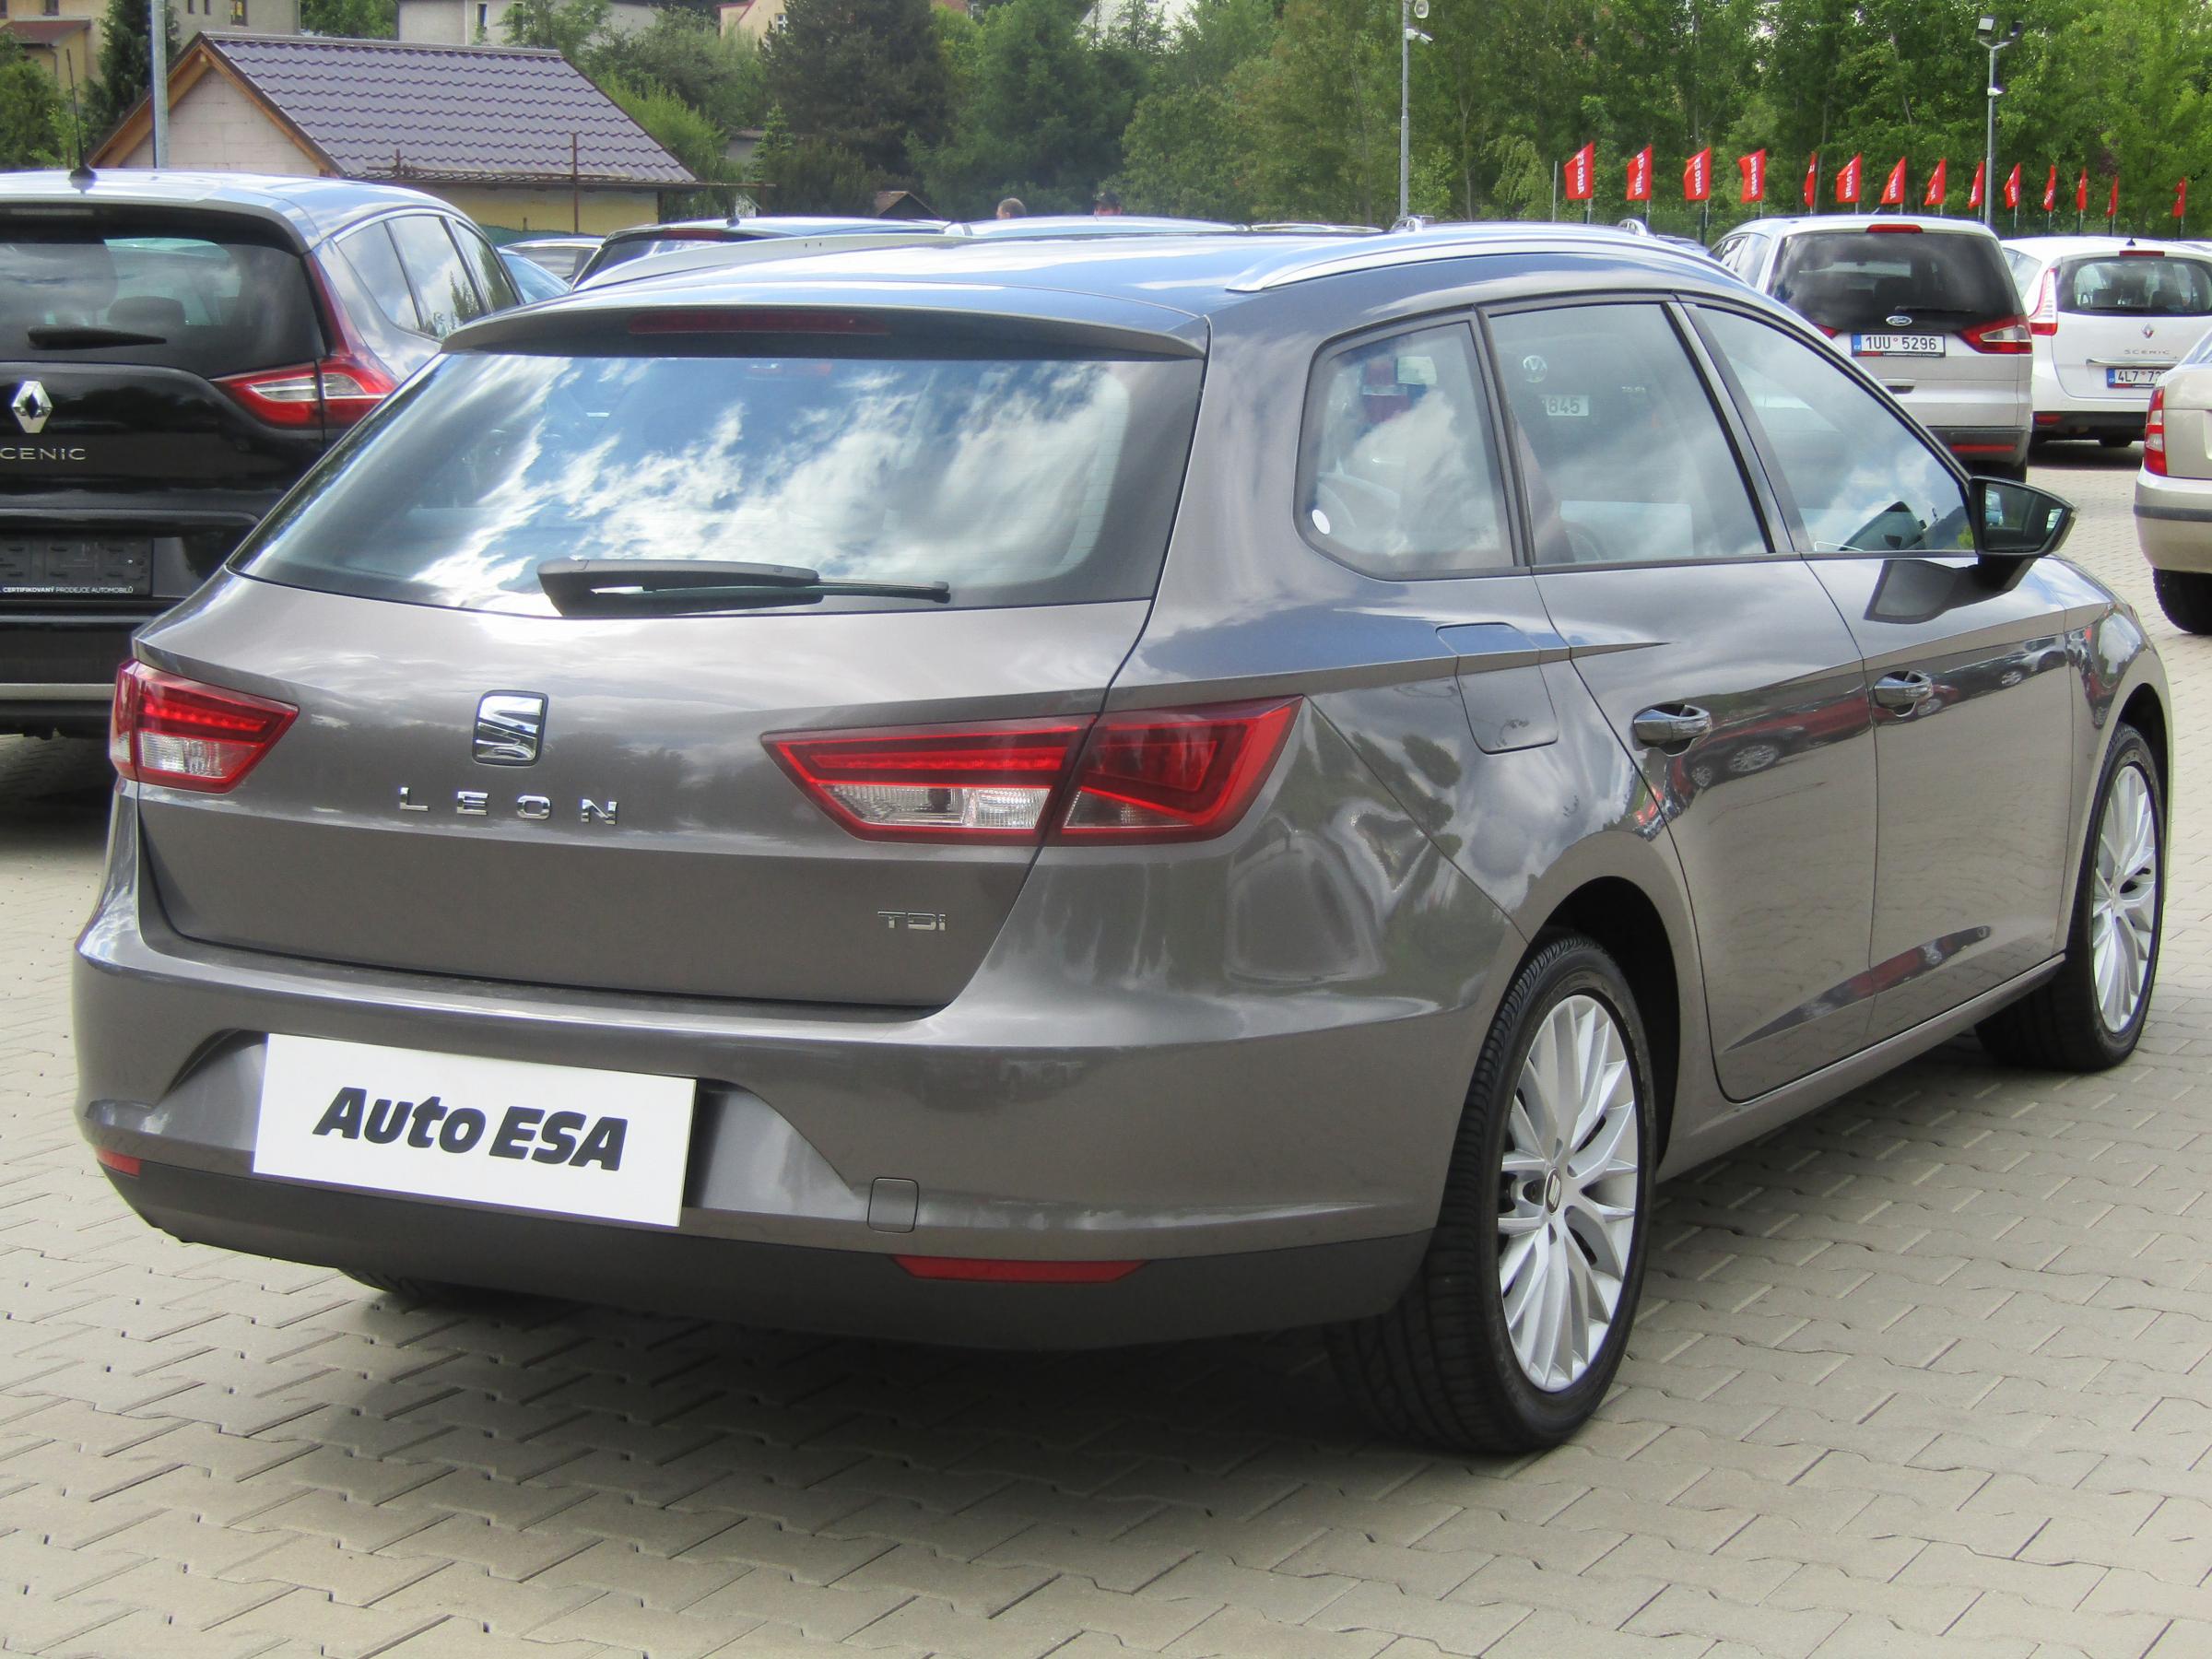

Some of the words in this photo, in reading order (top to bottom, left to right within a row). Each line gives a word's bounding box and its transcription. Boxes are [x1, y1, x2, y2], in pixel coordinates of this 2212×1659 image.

[1865, 335, 1891, 349] 1UU
[1901, 336, 1937, 350] 5296
[2117, 371, 2138, 382] 4L7
[3, 585, 55, 594] CERTIFIKOVANÝ
[91, 585, 134, 594] AUTOMOBILŮ
[399, 786, 618, 825] LEON
[312, 1087, 487, 1154] Auto
[488, 1105, 629, 1172] ESA
